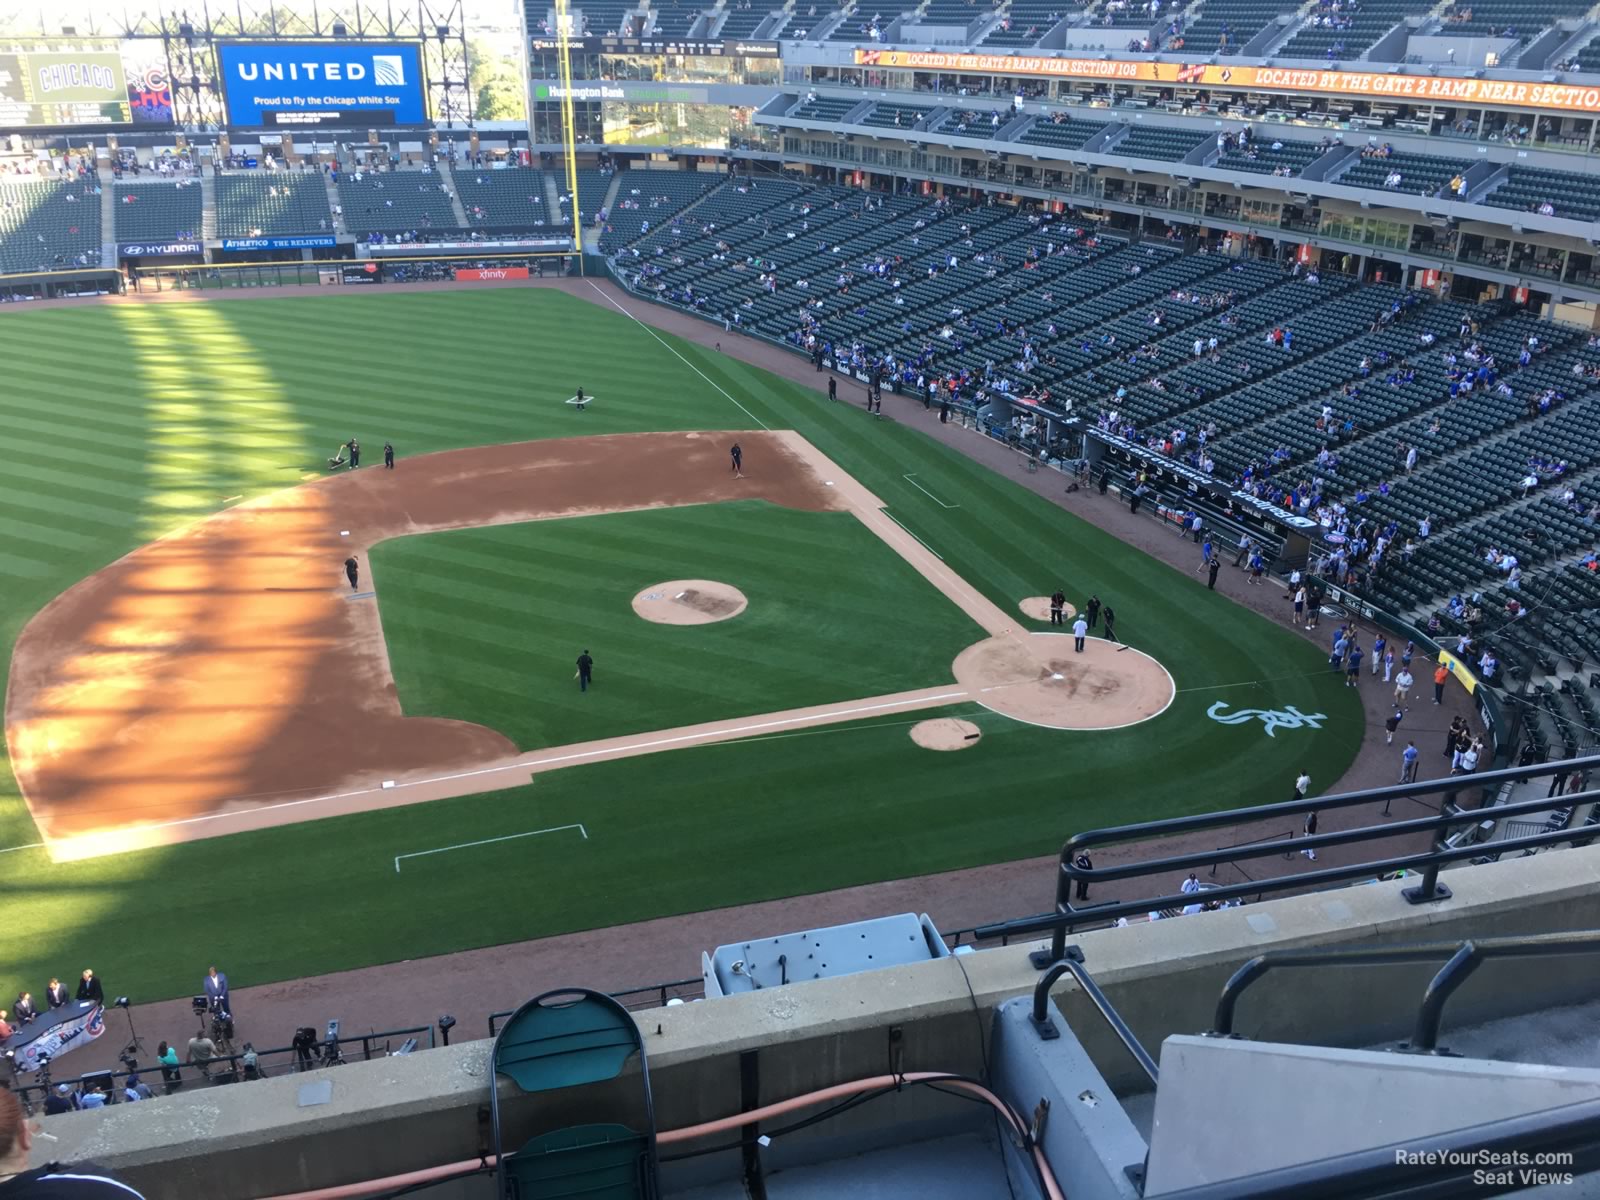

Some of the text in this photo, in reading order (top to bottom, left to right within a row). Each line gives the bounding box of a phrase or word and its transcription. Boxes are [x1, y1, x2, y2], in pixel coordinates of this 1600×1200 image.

[238, 63, 366, 81] UNITED
[907, 53, 1137, 76] LOCATED BY THE GATE 2 RAMP NEAR SECTION 108
[39, 63, 116, 92] CHICAGO
[601, 86, 625, 98] Bank
[1255, 70, 1600, 107] LOCATED BY THE GATE 2 RAMP NEAR SECTIO
[254, 96, 401, 107] Proud to fly the Chicago White Sox
[146, 244, 199, 254] HYUNDAI
[226, 239, 269, 248] ATHLETICO
[291, 238, 334, 246] RELIEVERS
[479, 269, 507, 279] xfinity
[1230, 490, 1295, 518] Ballpark
